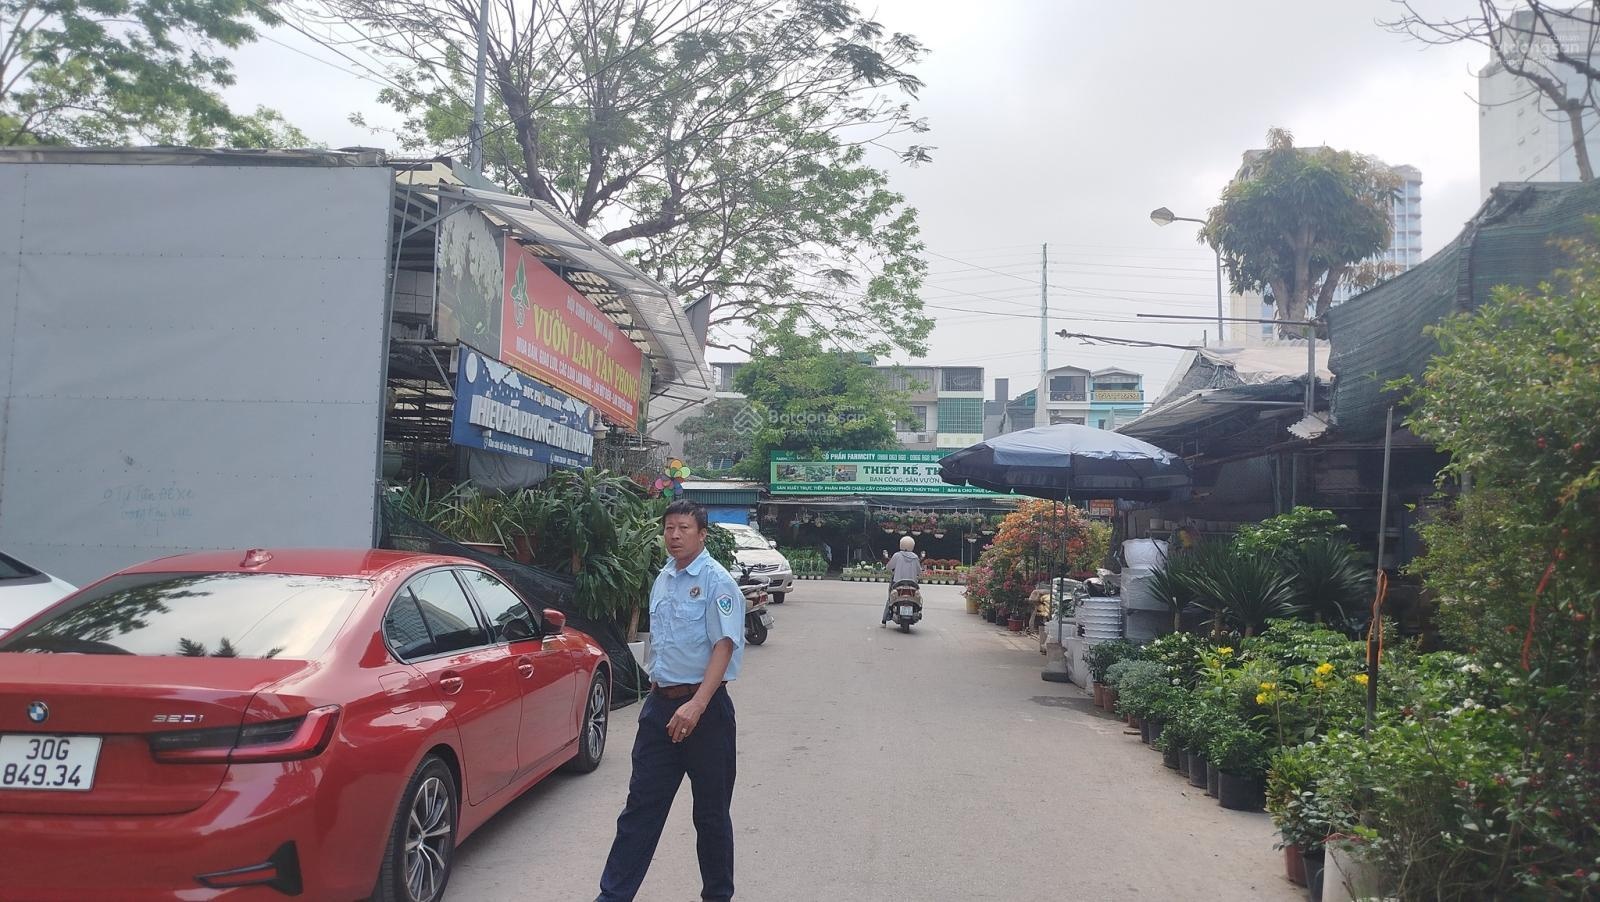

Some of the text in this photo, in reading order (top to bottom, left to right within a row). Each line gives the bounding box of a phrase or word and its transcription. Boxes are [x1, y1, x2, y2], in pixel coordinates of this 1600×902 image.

[533, 303, 570, 358] VƯỜN
[572, 331, 595, 373] LAN
[596, 342, 615, 386] TẤN
[615, 363, 639, 403] PHONG
[519, 407, 551, 446] PHONG
[847, 453, 876, 461] FARMCITY
[863, 464, 899, 475] THIẾT
[902, 464, 922, 476] KẾ,
[152, 714, 204, 723] 320i
[26, 738, 71, 761] 30G
[2, 763, 82, 787] 849.34
